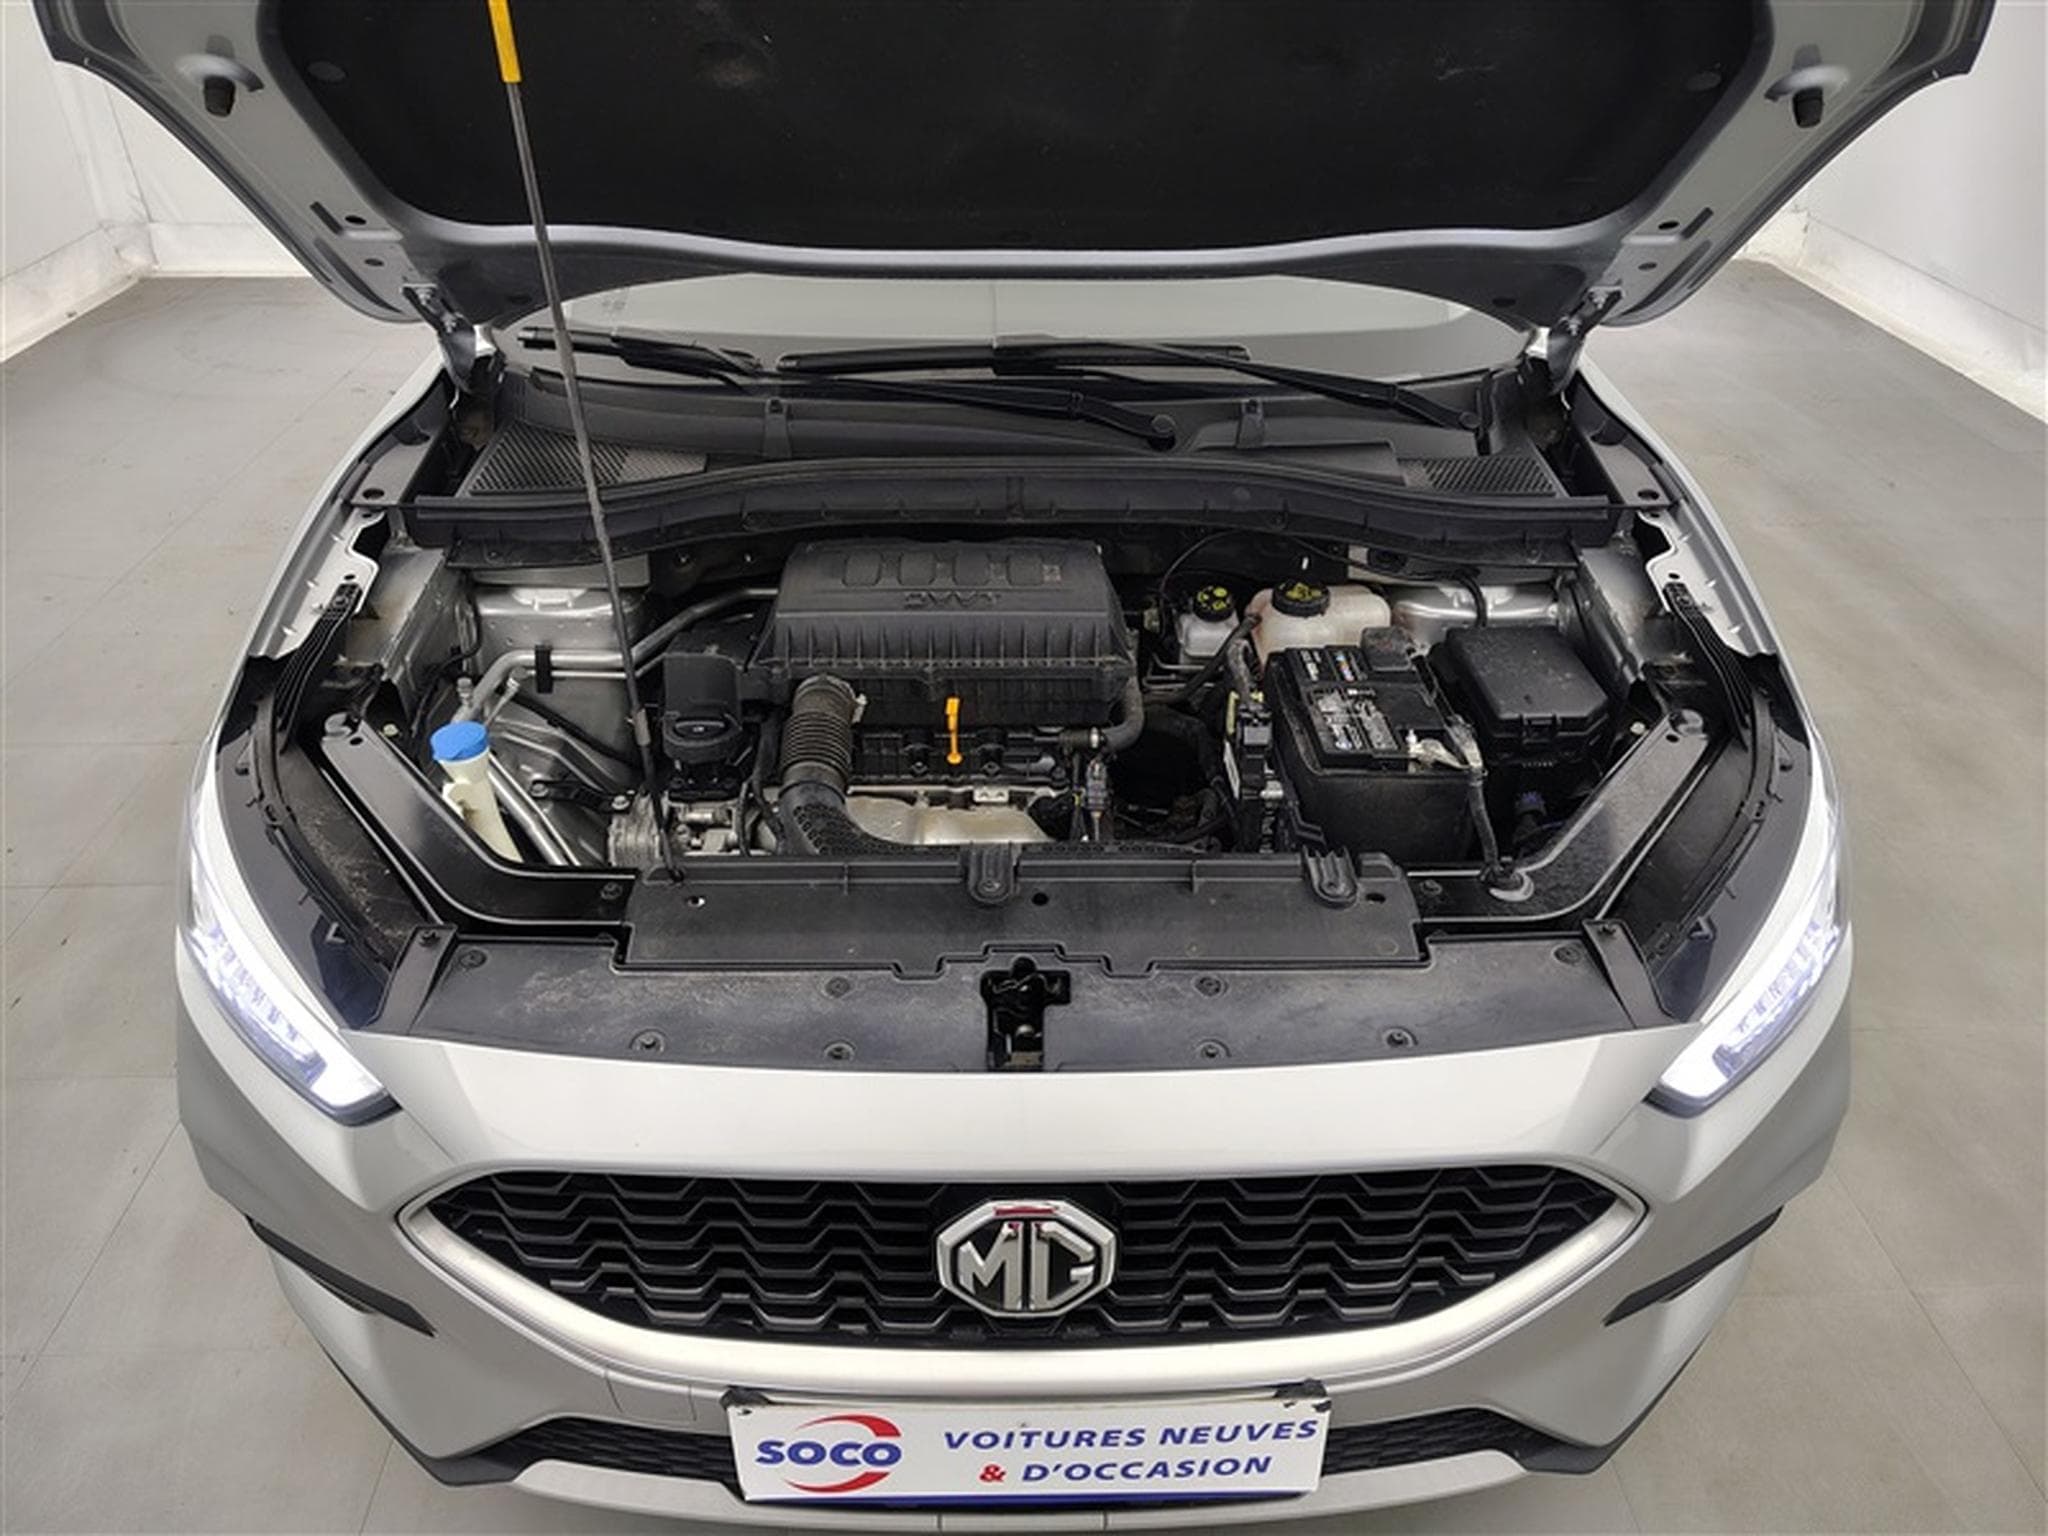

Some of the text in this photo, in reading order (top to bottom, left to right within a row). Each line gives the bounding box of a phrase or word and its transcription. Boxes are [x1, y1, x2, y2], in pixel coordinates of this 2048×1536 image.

[957, 1221, 1095, 1311] MG
[944, 1420, 1318, 1449] VOITURES NEUVES
[756, 1441, 902, 1467] SOCO
[979, 1464, 1006, 1483] &
